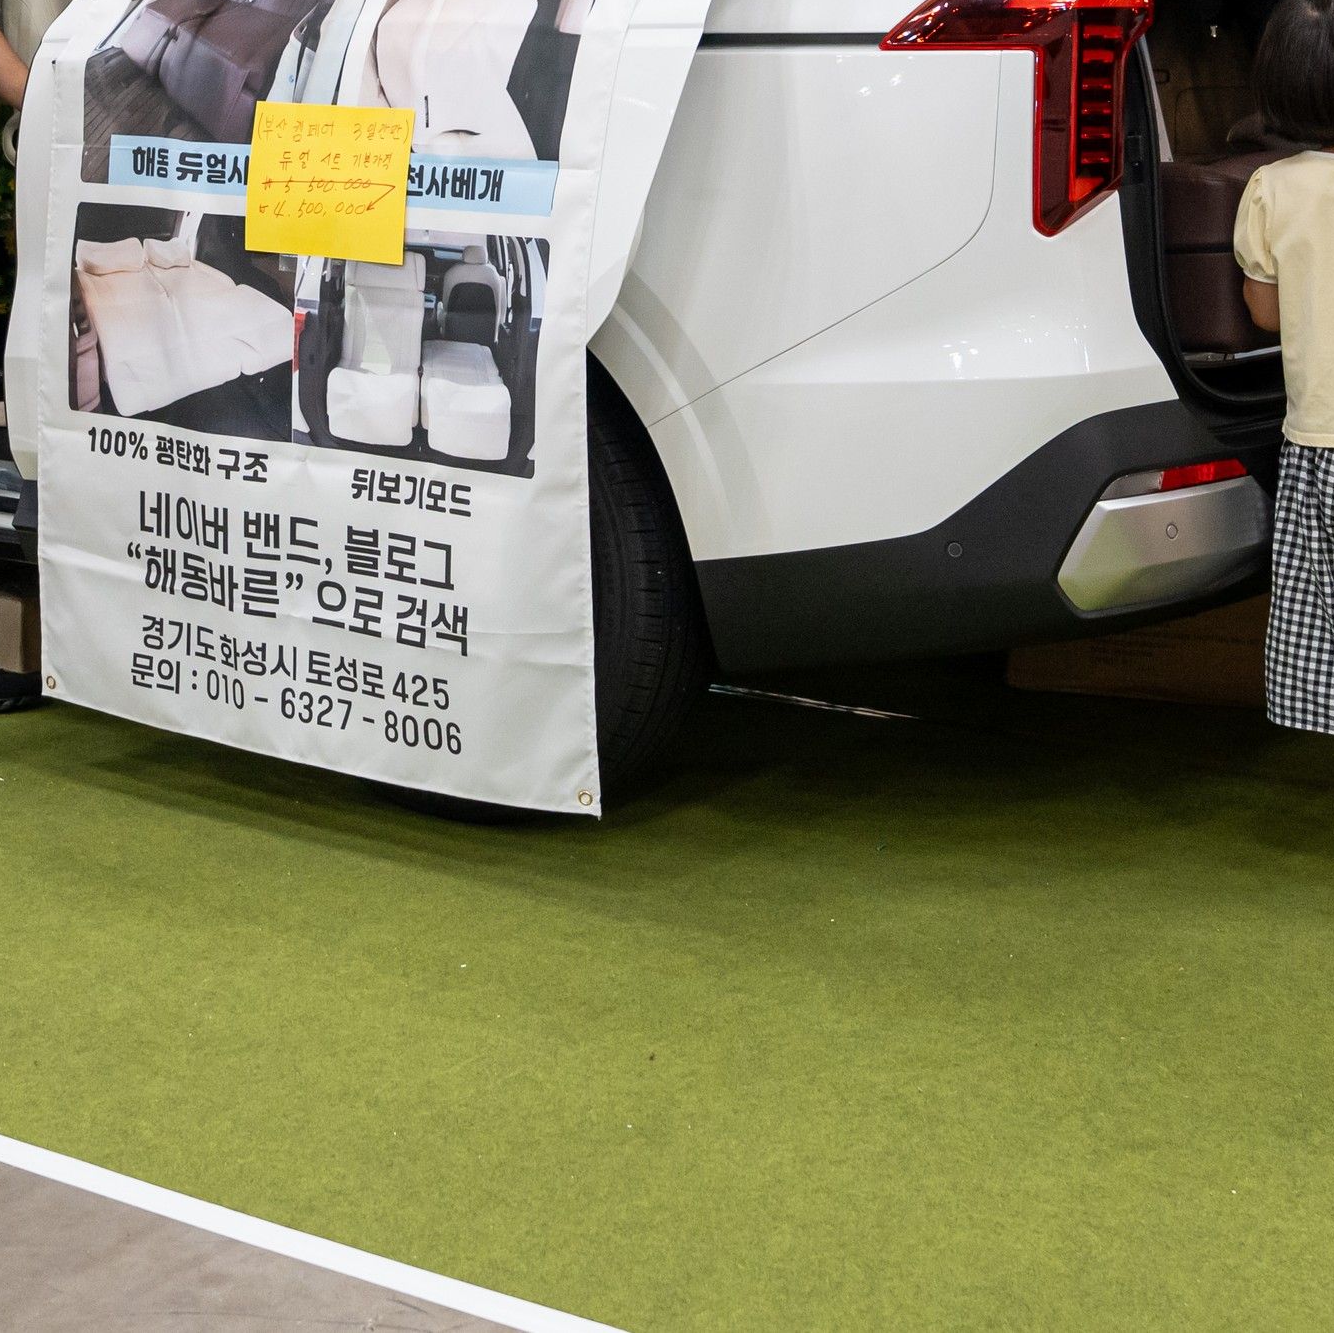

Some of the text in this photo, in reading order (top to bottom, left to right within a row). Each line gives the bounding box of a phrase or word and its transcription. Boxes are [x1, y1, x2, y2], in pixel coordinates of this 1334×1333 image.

[131, 146, 170, 179] 해동
[175, 151, 249, 186] 듀얼시
[87, 426, 269, 484] 100% 평탄화 구조
[350, 467, 472, 518] 뒤보기모드
[139, 489, 456, 592] 네이버 밴드, 블로그
[394, 593, 469, 658] 검색
[130, 651, 182, 695] 문의
[206, 668, 246, 711] 010
[280, 686, 354, 731] 6327
[383, 709, 464, 757] 8006
[304, 649, 387, 701] 토성로
[392, 670, 451, 712] 425
